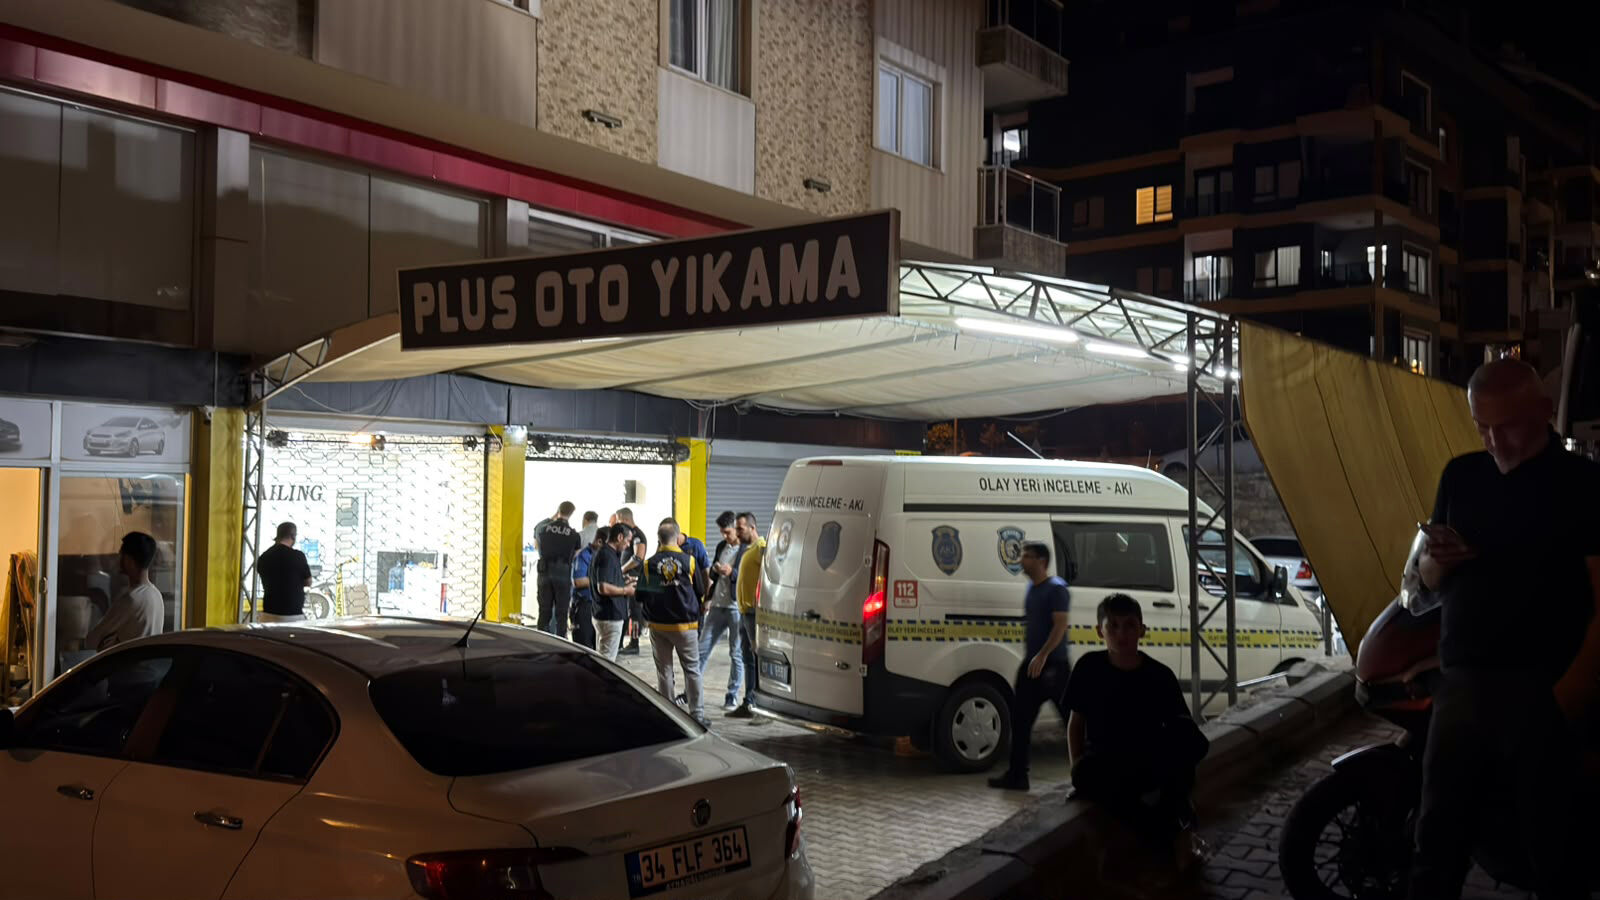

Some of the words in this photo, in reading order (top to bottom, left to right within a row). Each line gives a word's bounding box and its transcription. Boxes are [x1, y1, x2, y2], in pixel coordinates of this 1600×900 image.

[413, 275, 517, 335] PLUS
[535, 264, 628, 328] OTO
[651, 235, 861, 318] YIKAMA
[979, 477, 1010, 491] OLAY
[897, 582, 914, 597] 112
[641, 852, 666, 883] 34
[672, 842, 704, 875] FLF
[711, 831, 743, 864] 364
